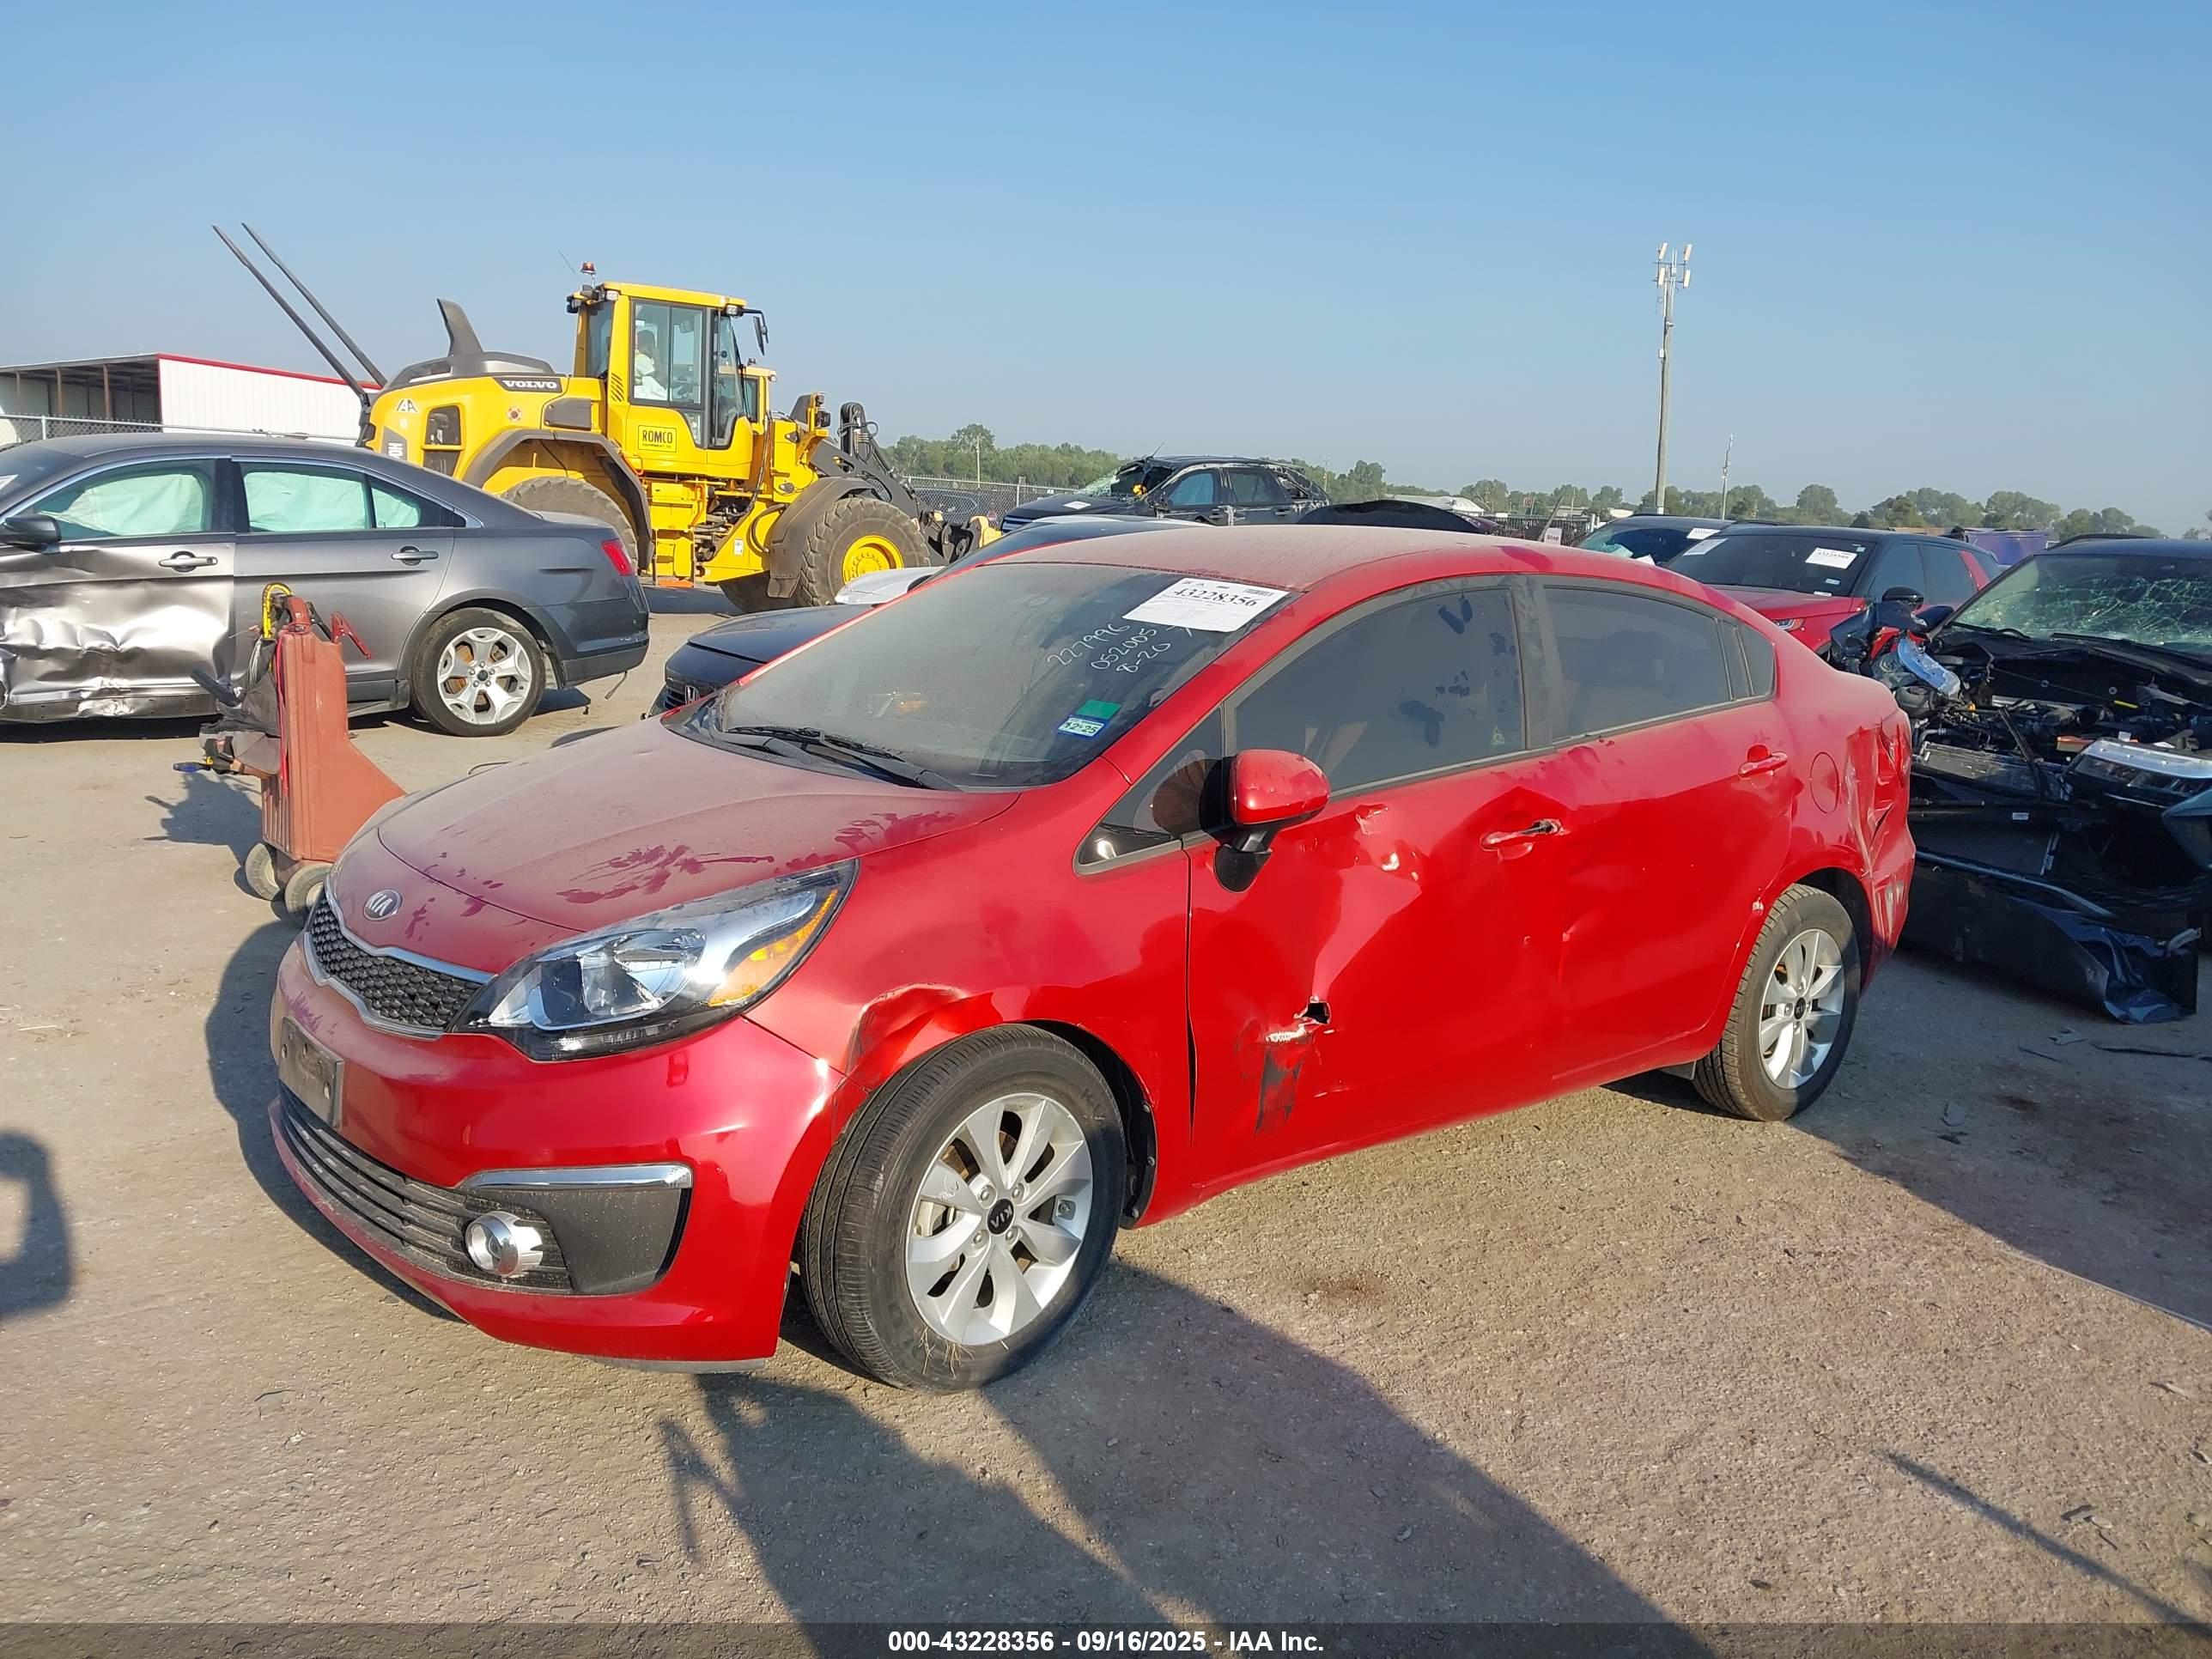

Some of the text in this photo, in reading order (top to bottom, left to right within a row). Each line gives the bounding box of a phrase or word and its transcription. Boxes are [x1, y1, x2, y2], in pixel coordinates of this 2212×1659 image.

[501, 380, 557, 388] VOLVO
[642, 429, 673, 444] ROMCO
[1174, 587, 1262, 606] 43228356
[1047, 623, 1131, 665] 227996
[1091, 628, 1158, 670] 052005
[1115, 642, 1171, 673] 8-20
[368, 893, 392, 916] KIA
[990, 1205, 1013, 1229] KIA
